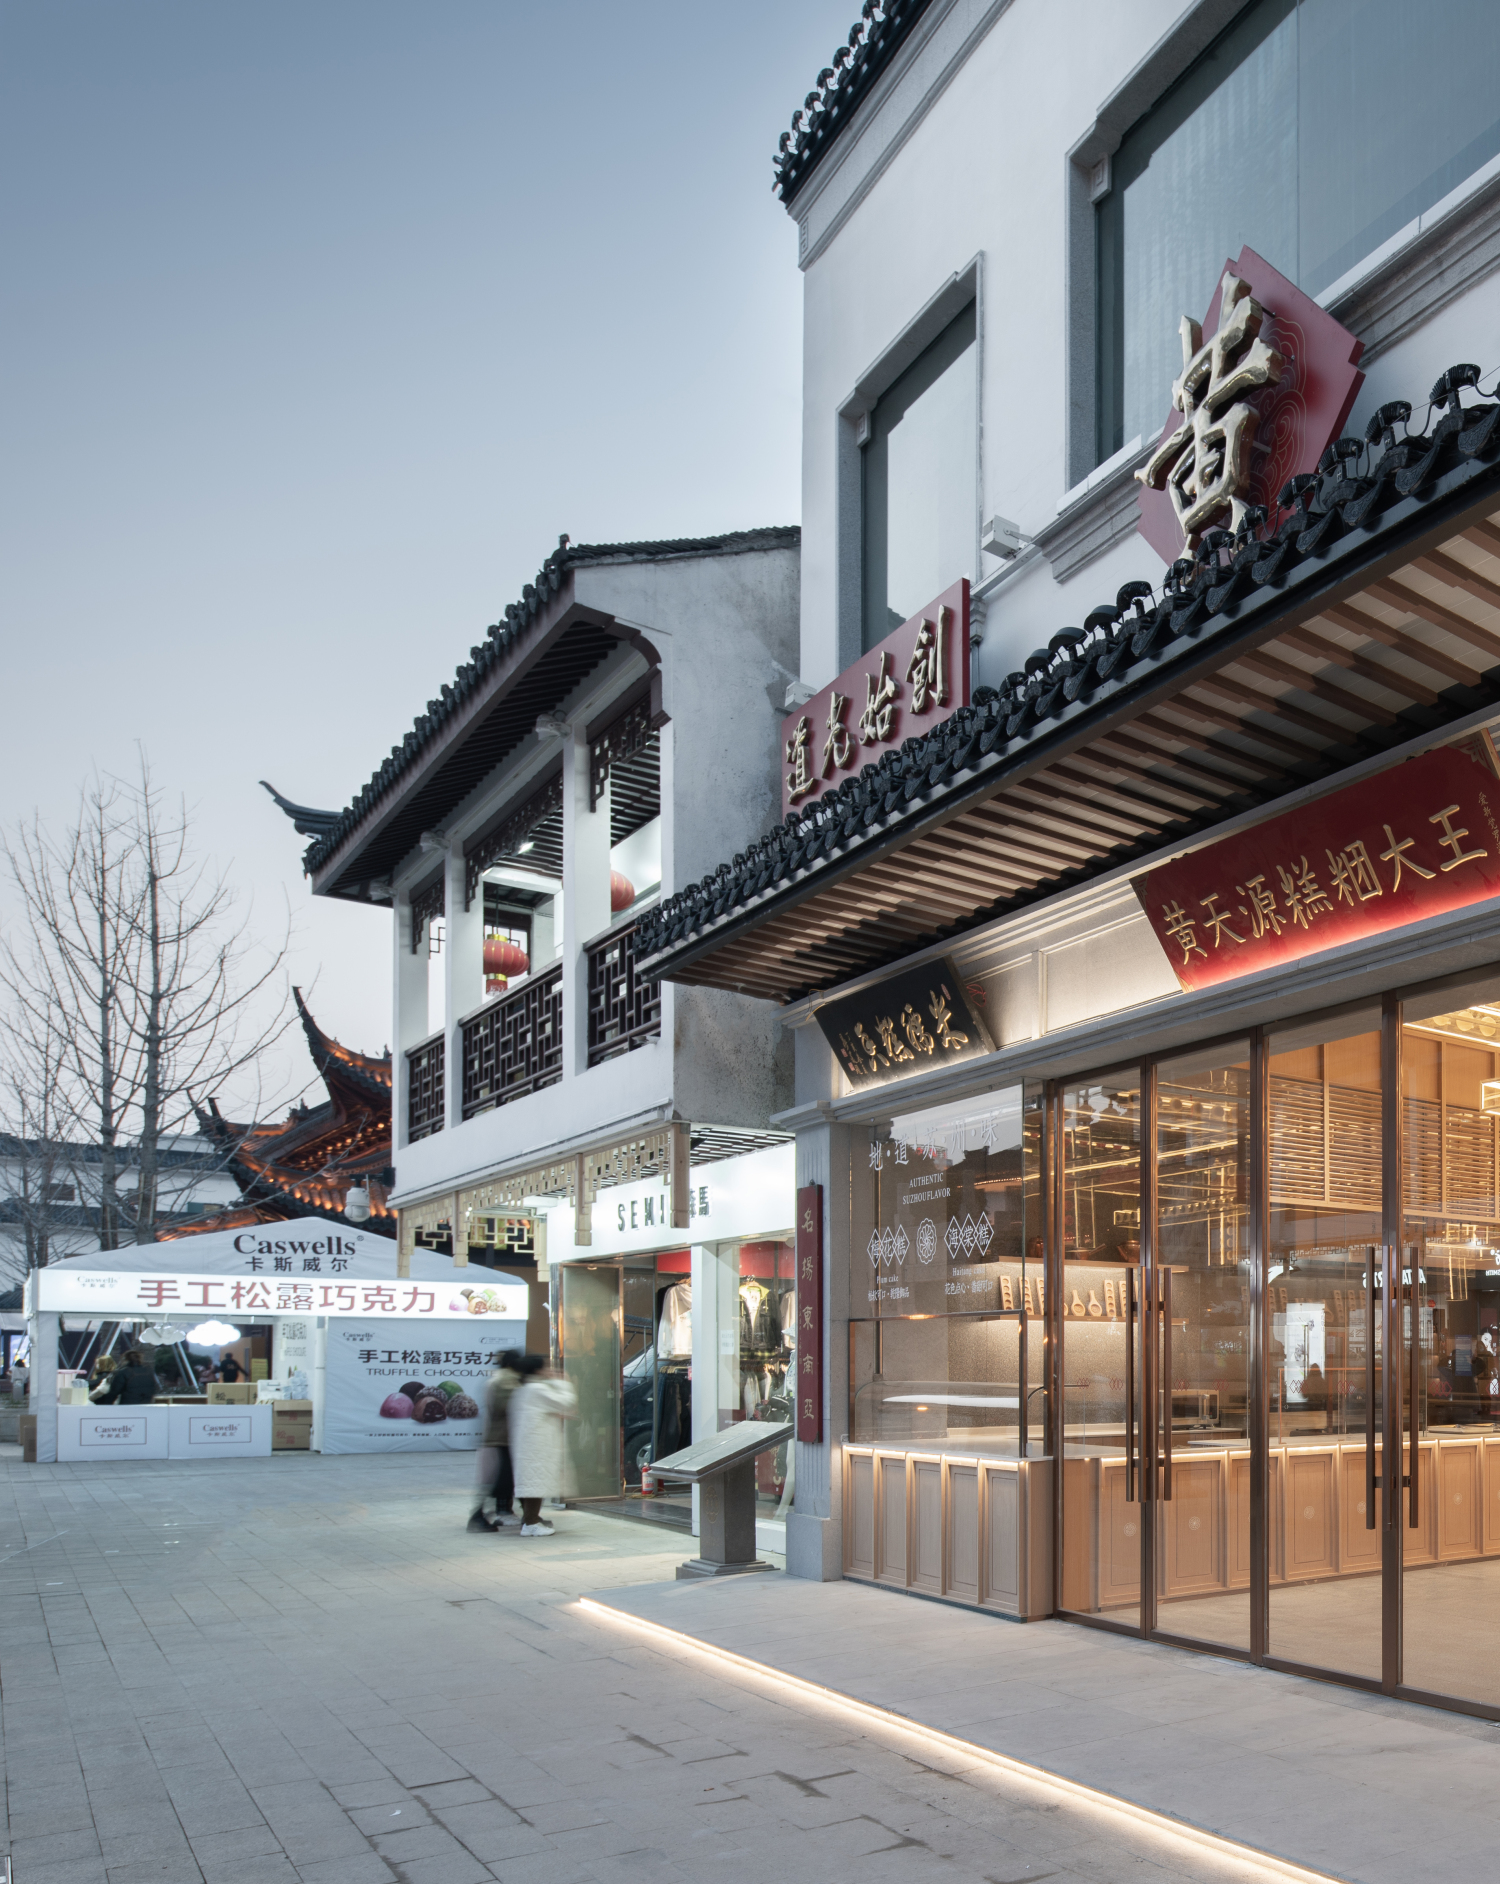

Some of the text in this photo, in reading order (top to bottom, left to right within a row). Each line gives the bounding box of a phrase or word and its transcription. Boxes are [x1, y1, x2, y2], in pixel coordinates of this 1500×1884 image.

[909, 1172, 944, 1188] AUTHENTIC
[618, 1194, 665, 1232] SEMI
[233, 1234, 356, 1256] Caswells
[245, 1256, 348, 1272] 卡斯威尔
[77, 1275, 117, 1284] Caswells
[137, 1279, 436, 1313] 手工松露巧克力
[366, 1368, 420, 1377] TRUFFLE
[94, 1424, 132, 1434] Caswells
[203, 1423, 238, 1432] Caswells
